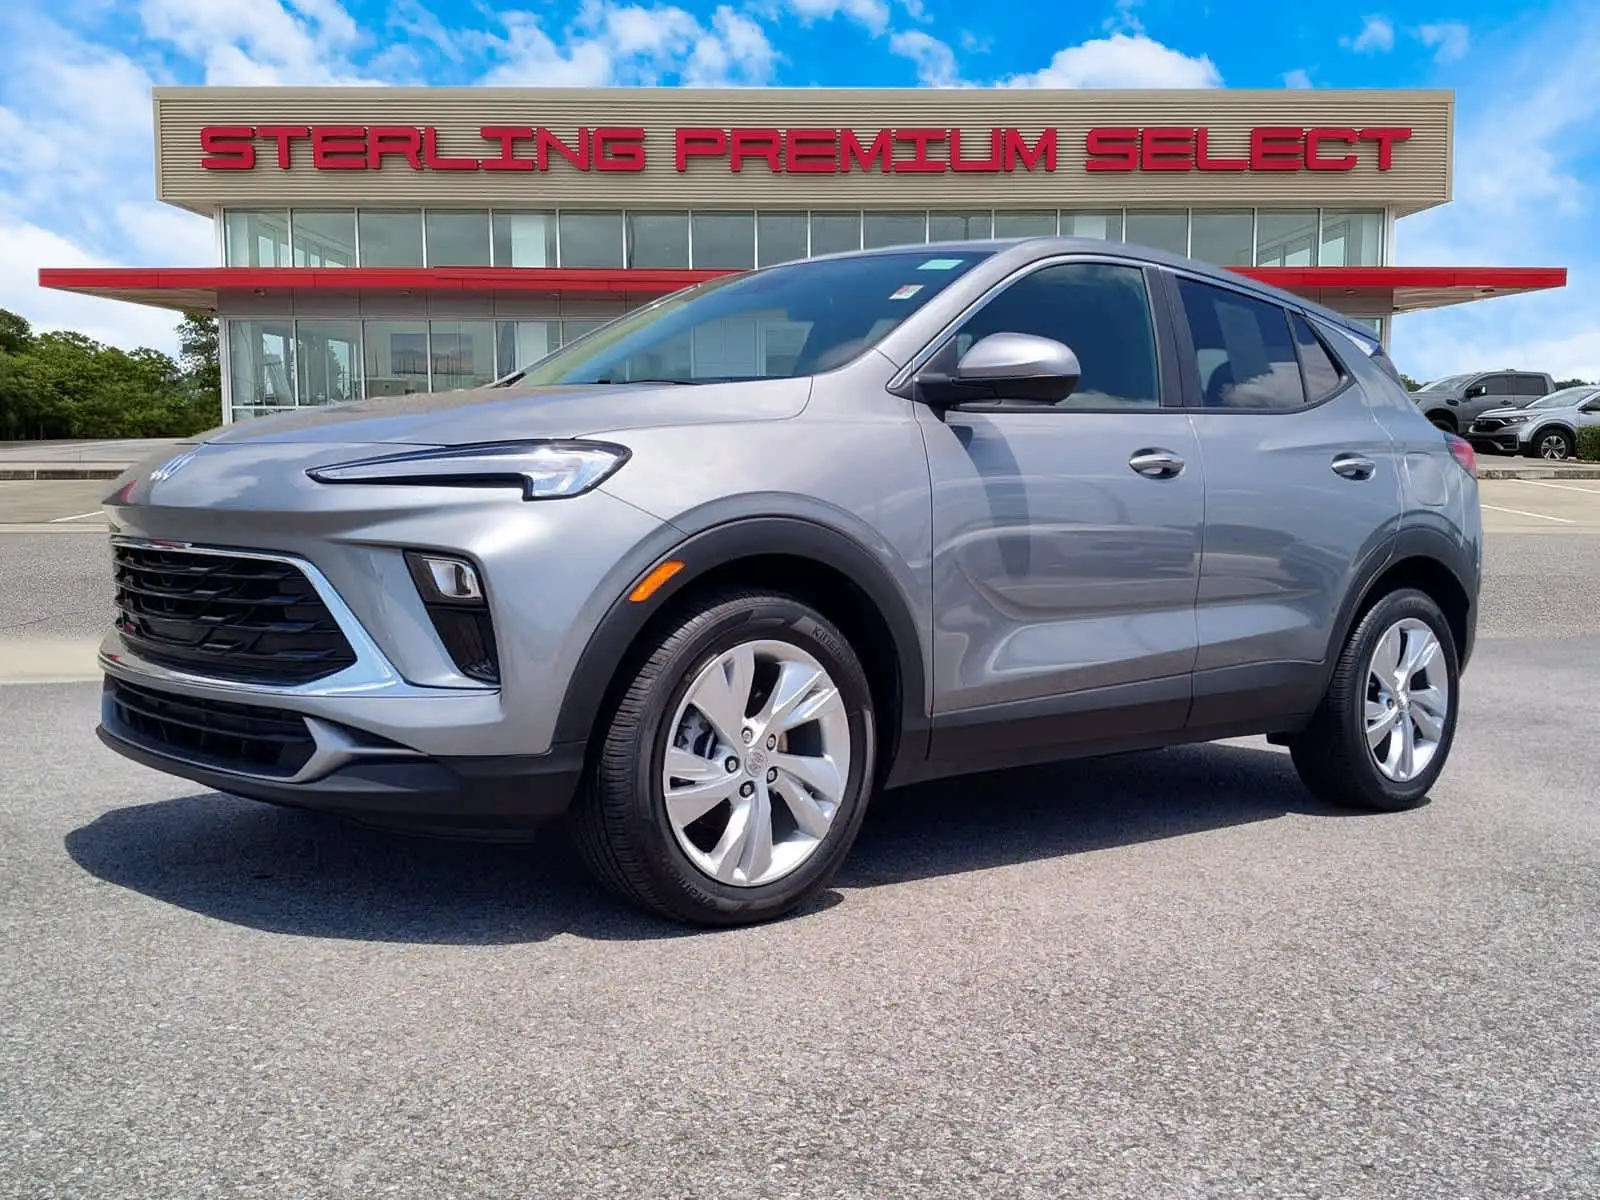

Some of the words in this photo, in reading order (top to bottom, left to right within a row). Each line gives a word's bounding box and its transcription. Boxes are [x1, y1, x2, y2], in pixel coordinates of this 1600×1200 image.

[200, 126, 646, 172] STERLING
[674, 127, 1058, 173] PREMIUM
[1085, 127, 1413, 171] SELECT
